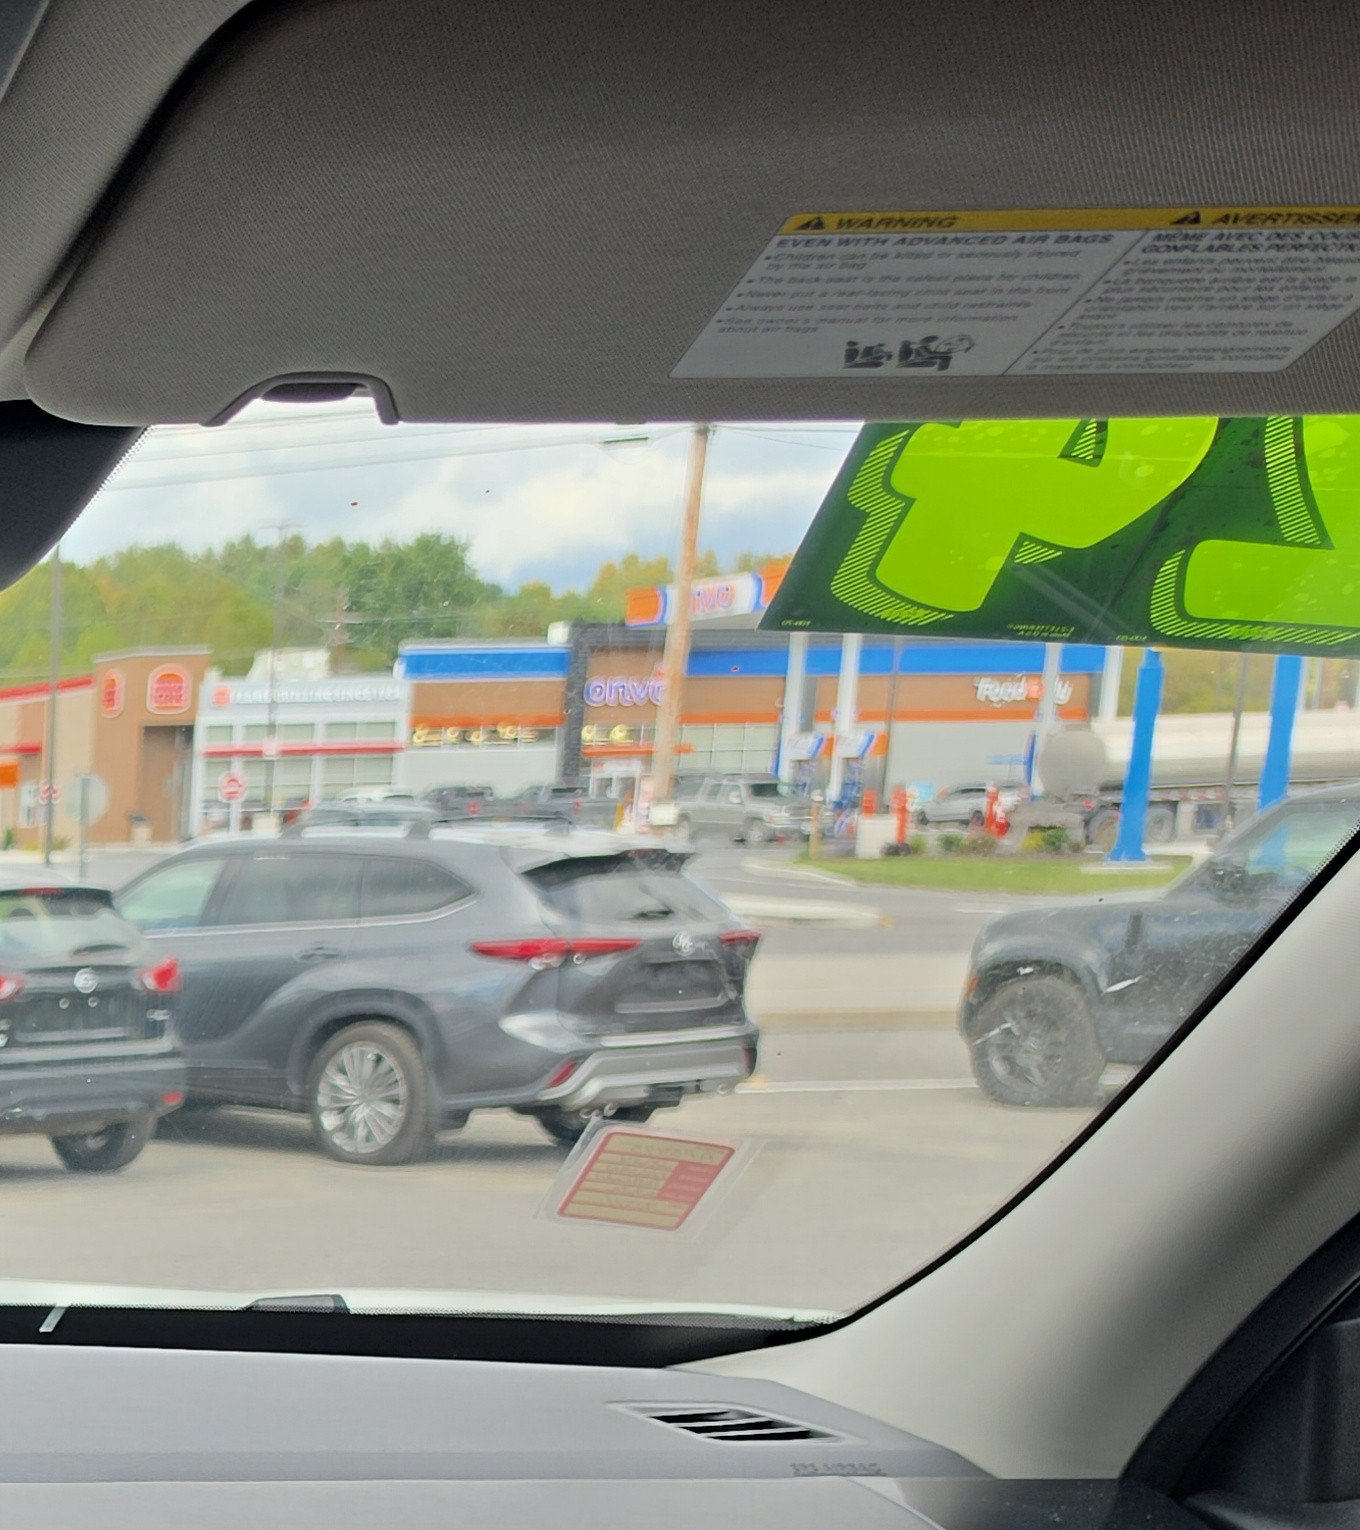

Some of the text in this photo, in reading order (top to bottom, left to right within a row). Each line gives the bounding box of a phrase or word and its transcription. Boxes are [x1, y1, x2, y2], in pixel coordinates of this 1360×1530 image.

[835, 216, 959, 229] WARNING
[777, 234, 1114, 248] EVEN WITH ADVANCED AIR BAGS
